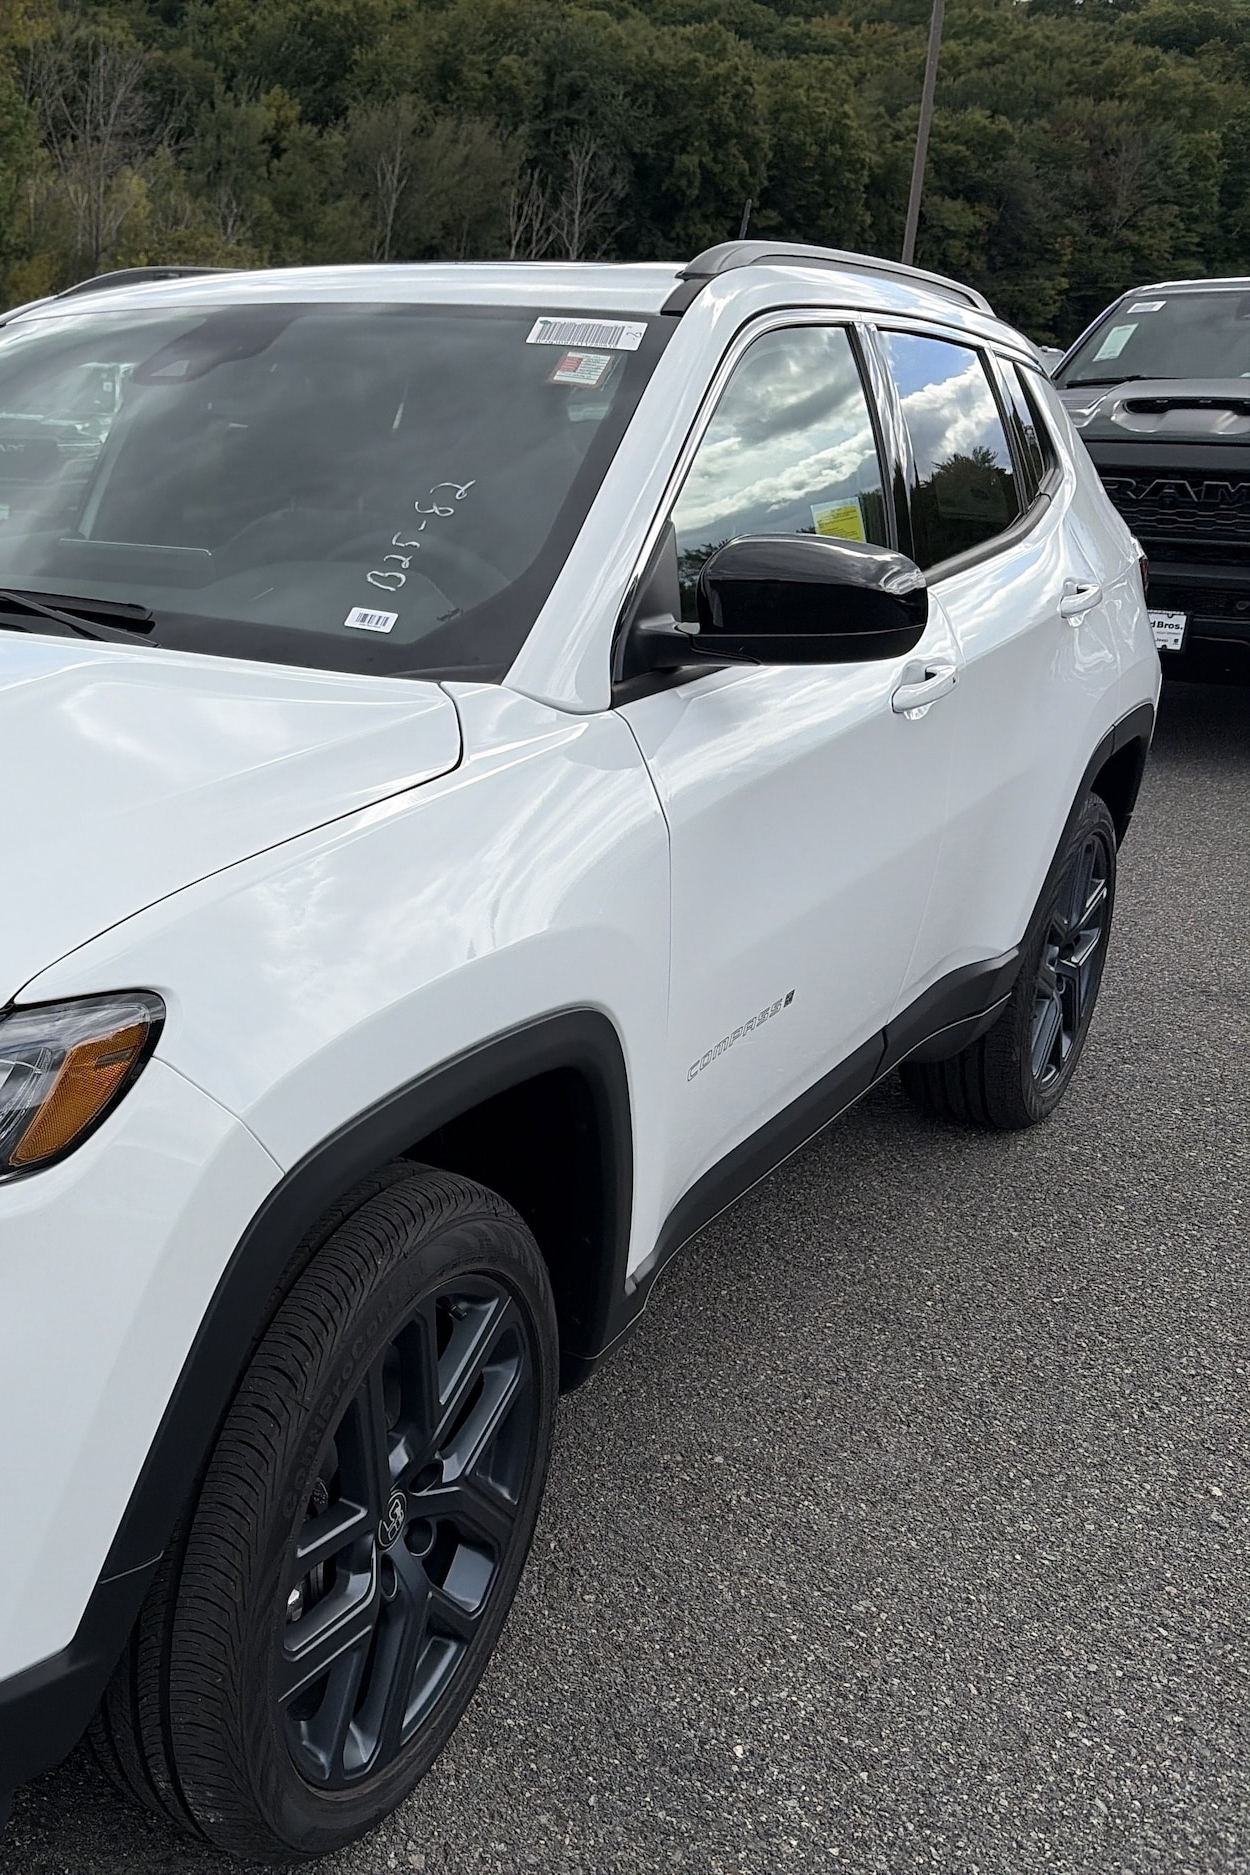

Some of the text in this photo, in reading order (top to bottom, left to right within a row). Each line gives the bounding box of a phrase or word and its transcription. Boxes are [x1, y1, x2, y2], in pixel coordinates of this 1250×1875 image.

[366, 480, 476, 592] B25-82
[1156, 620, 1184, 630] Bros.
[687, 998, 784, 1082] COMPASS
